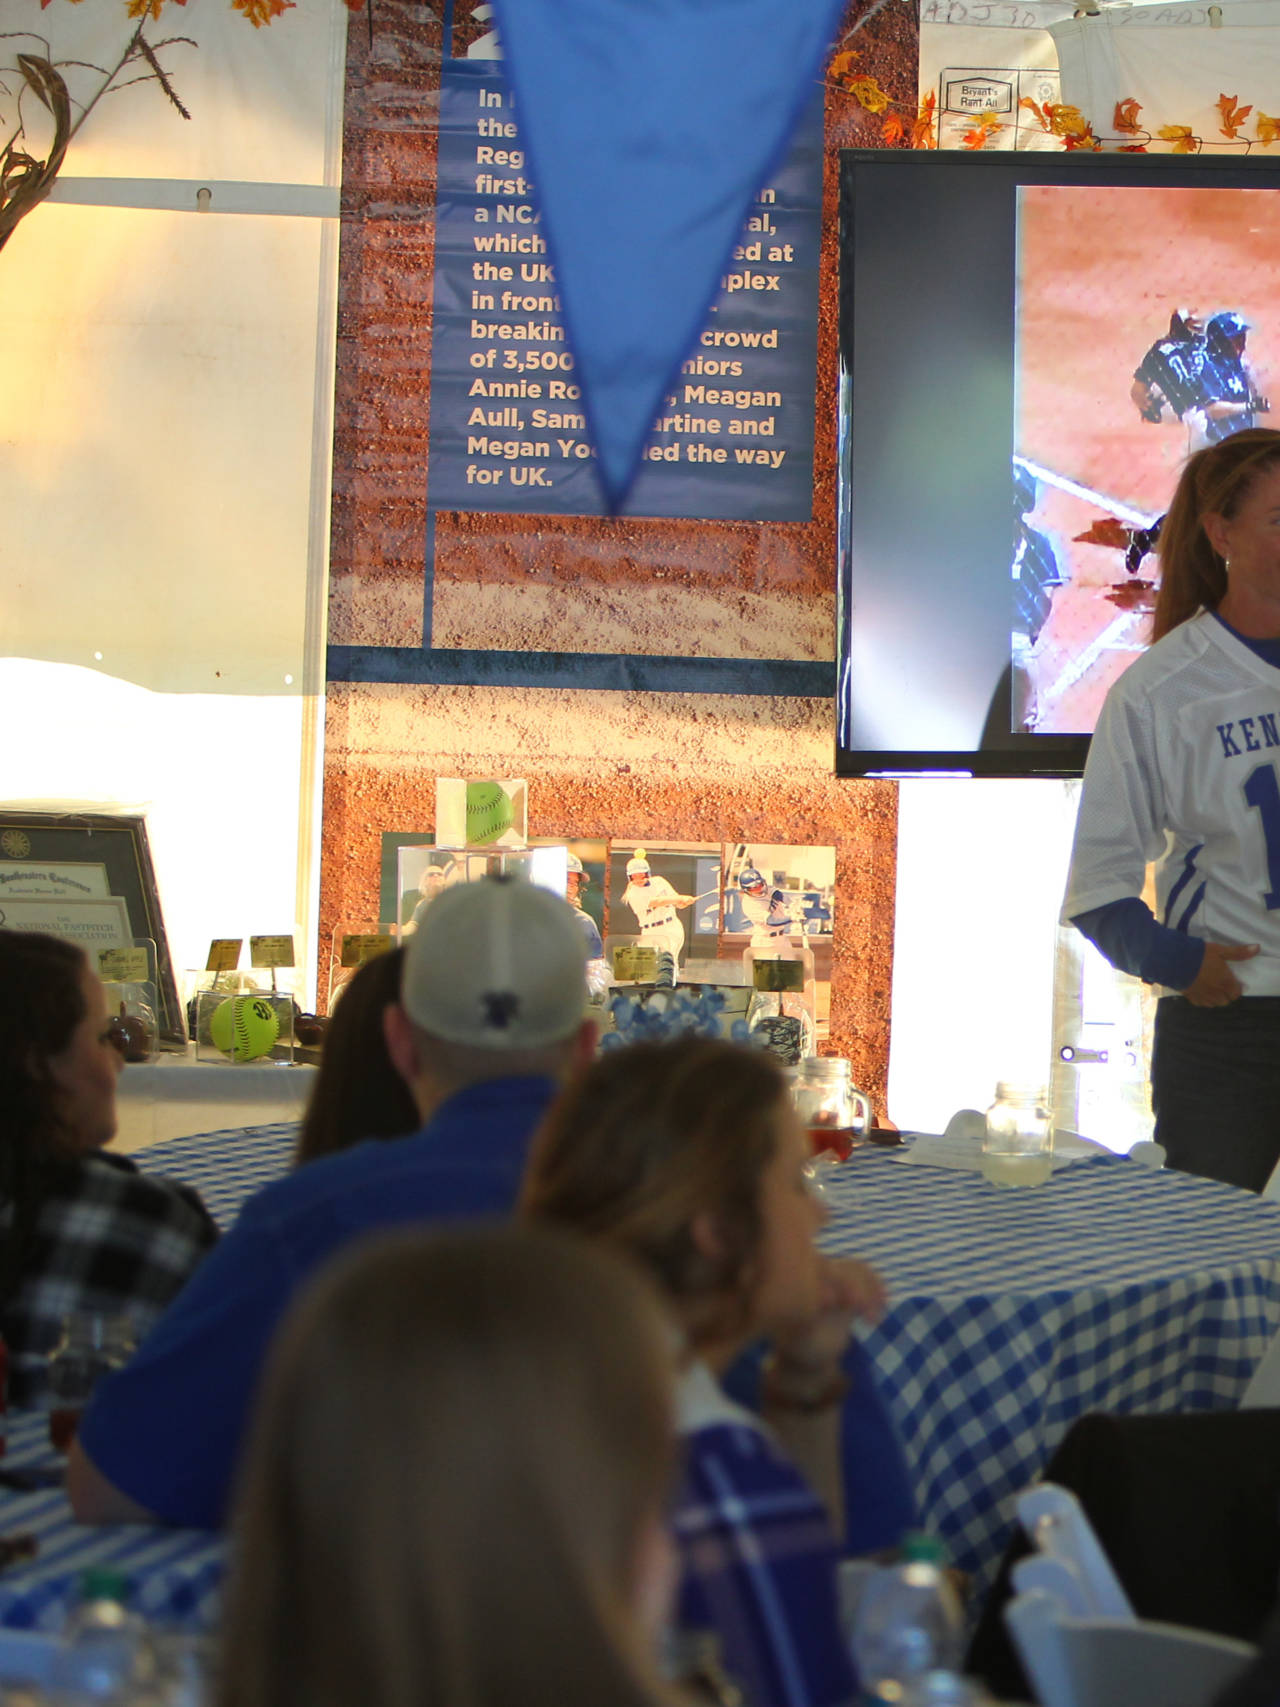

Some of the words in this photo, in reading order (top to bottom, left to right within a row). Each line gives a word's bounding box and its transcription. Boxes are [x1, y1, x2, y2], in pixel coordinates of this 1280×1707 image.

[480, 88, 502, 108] In
[477, 117, 518, 138] the
[476, 146, 525, 169] Reg
[474, 174, 536, 196] first-
[474, 207, 489, 223] a
[743, 212, 777, 236] al,
[473, 233, 547, 254] which
[732, 241, 762, 261] ed
[768, 243, 794, 263] at
[472, 261, 514, 282] the
[521, 263, 557, 283] UK
[721, 270, 781, 293] plex
[472, 290, 494, 310] in
[501, 291, 562, 312] front
[700, 329, 779, 348] crowd
[470, 348, 497, 368] of
[503, 349, 576, 373] 3,500
[468, 378, 542, 399] Annie
[548, 380, 582, 400] Ro
[684, 384, 782, 409] Meagan
[467, 406, 525, 431] Aull,
[531, 409, 587, 430] Sam
[728, 416, 775, 436] and
[467, 436, 550, 460] Megan
[557, 439, 598, 459] Yo
[686, 443, 728, 463] the
[735, 449, 786, 469] way
[466, 464, 504, 485] for
[510, 466, 553, 487] UK.
